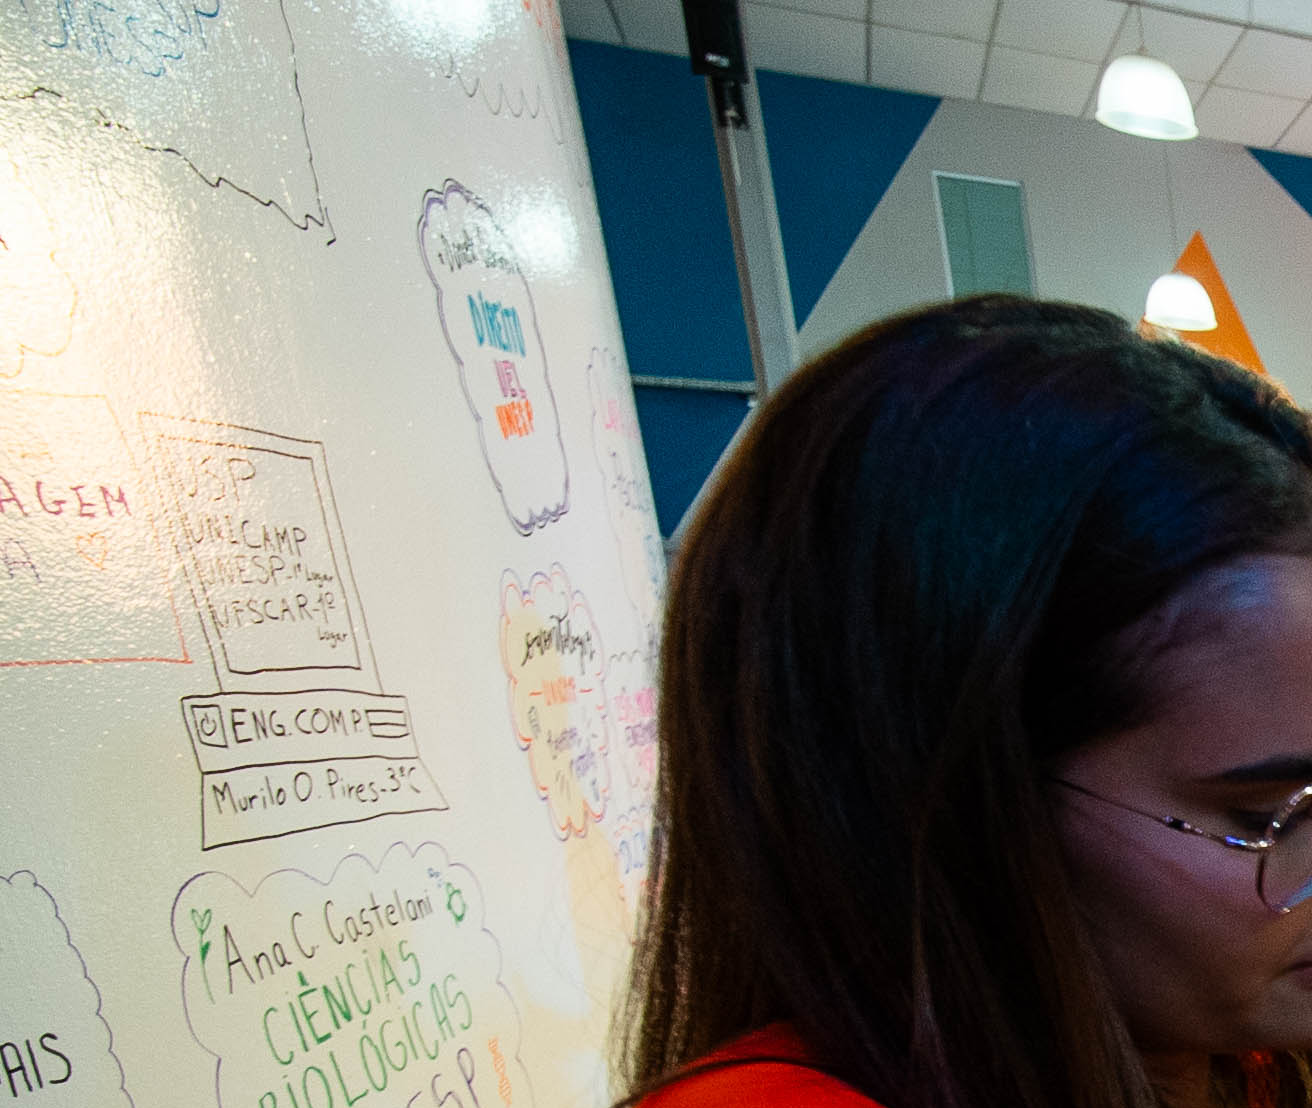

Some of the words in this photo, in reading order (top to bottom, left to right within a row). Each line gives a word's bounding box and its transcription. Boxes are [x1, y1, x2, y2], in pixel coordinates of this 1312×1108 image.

[183, 512, 307, 556] UNICAMP
[212, 774, 287, 814] Murilo
[223, 924, 293, 995] Ana
